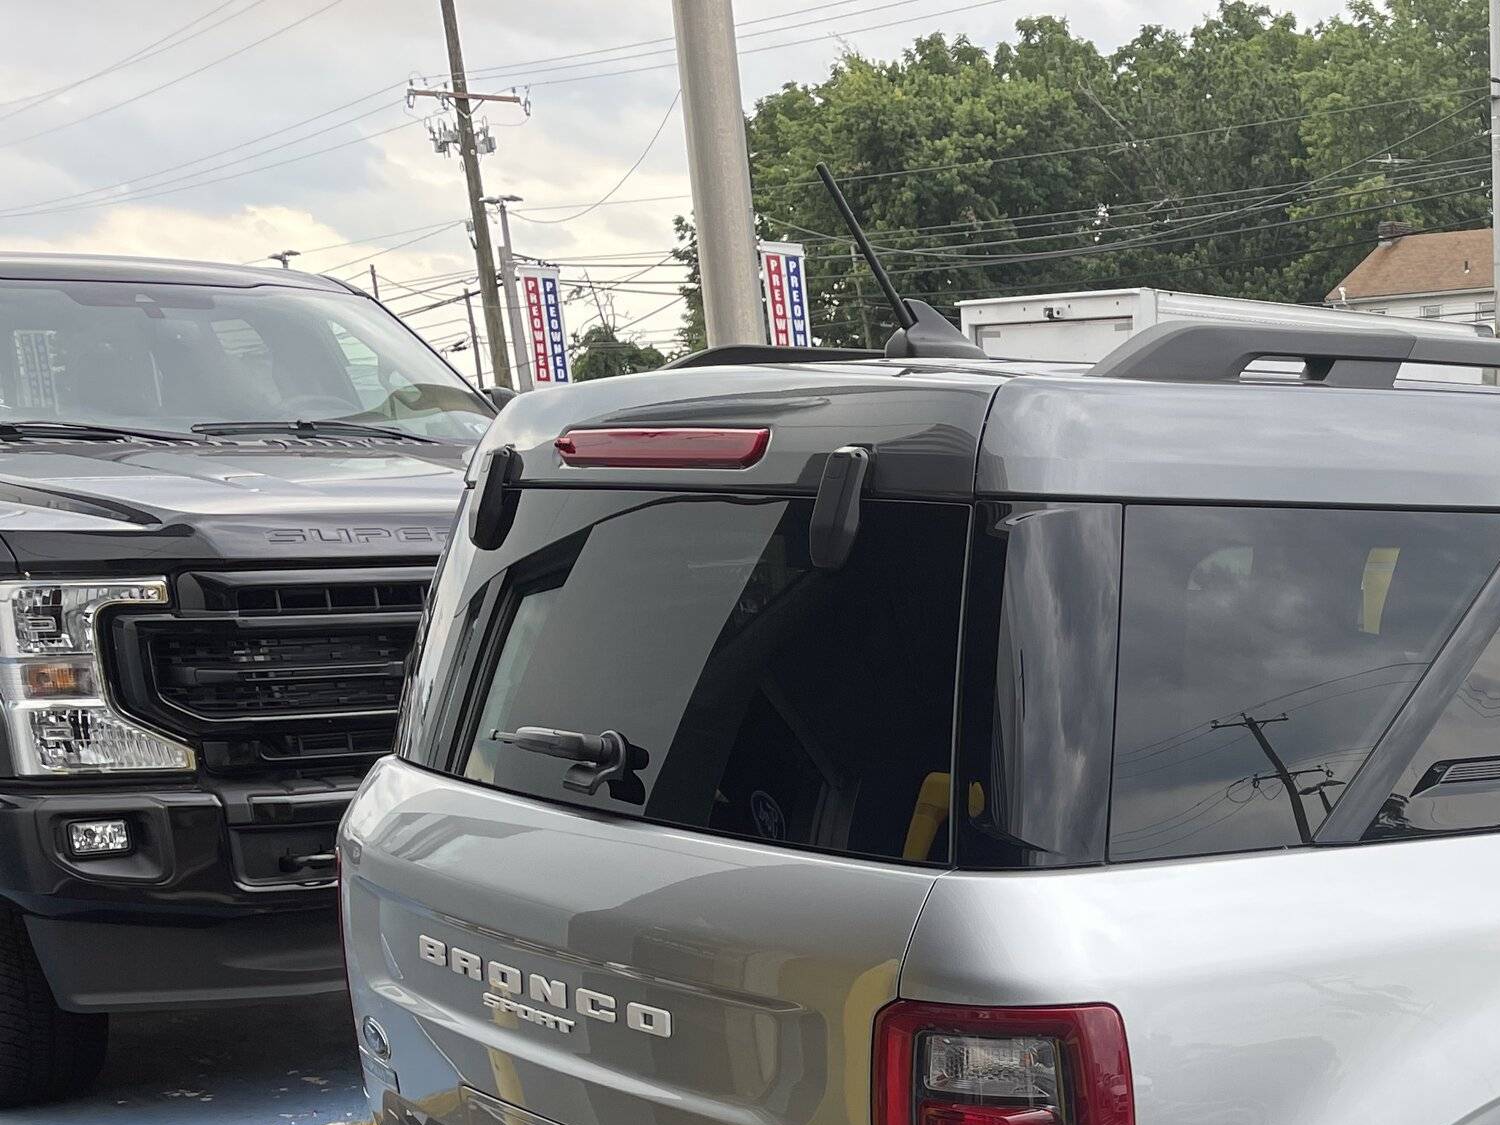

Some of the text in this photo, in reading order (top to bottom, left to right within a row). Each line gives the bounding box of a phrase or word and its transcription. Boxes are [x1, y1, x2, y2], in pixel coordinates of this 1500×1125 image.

[527, 280, 548, 379] PREOWNED
[544, 280, 566, 380] PREOWNED
[418, 933, 673, 1039] BRONCO
[482, 991, 577, 1034] SPORT
